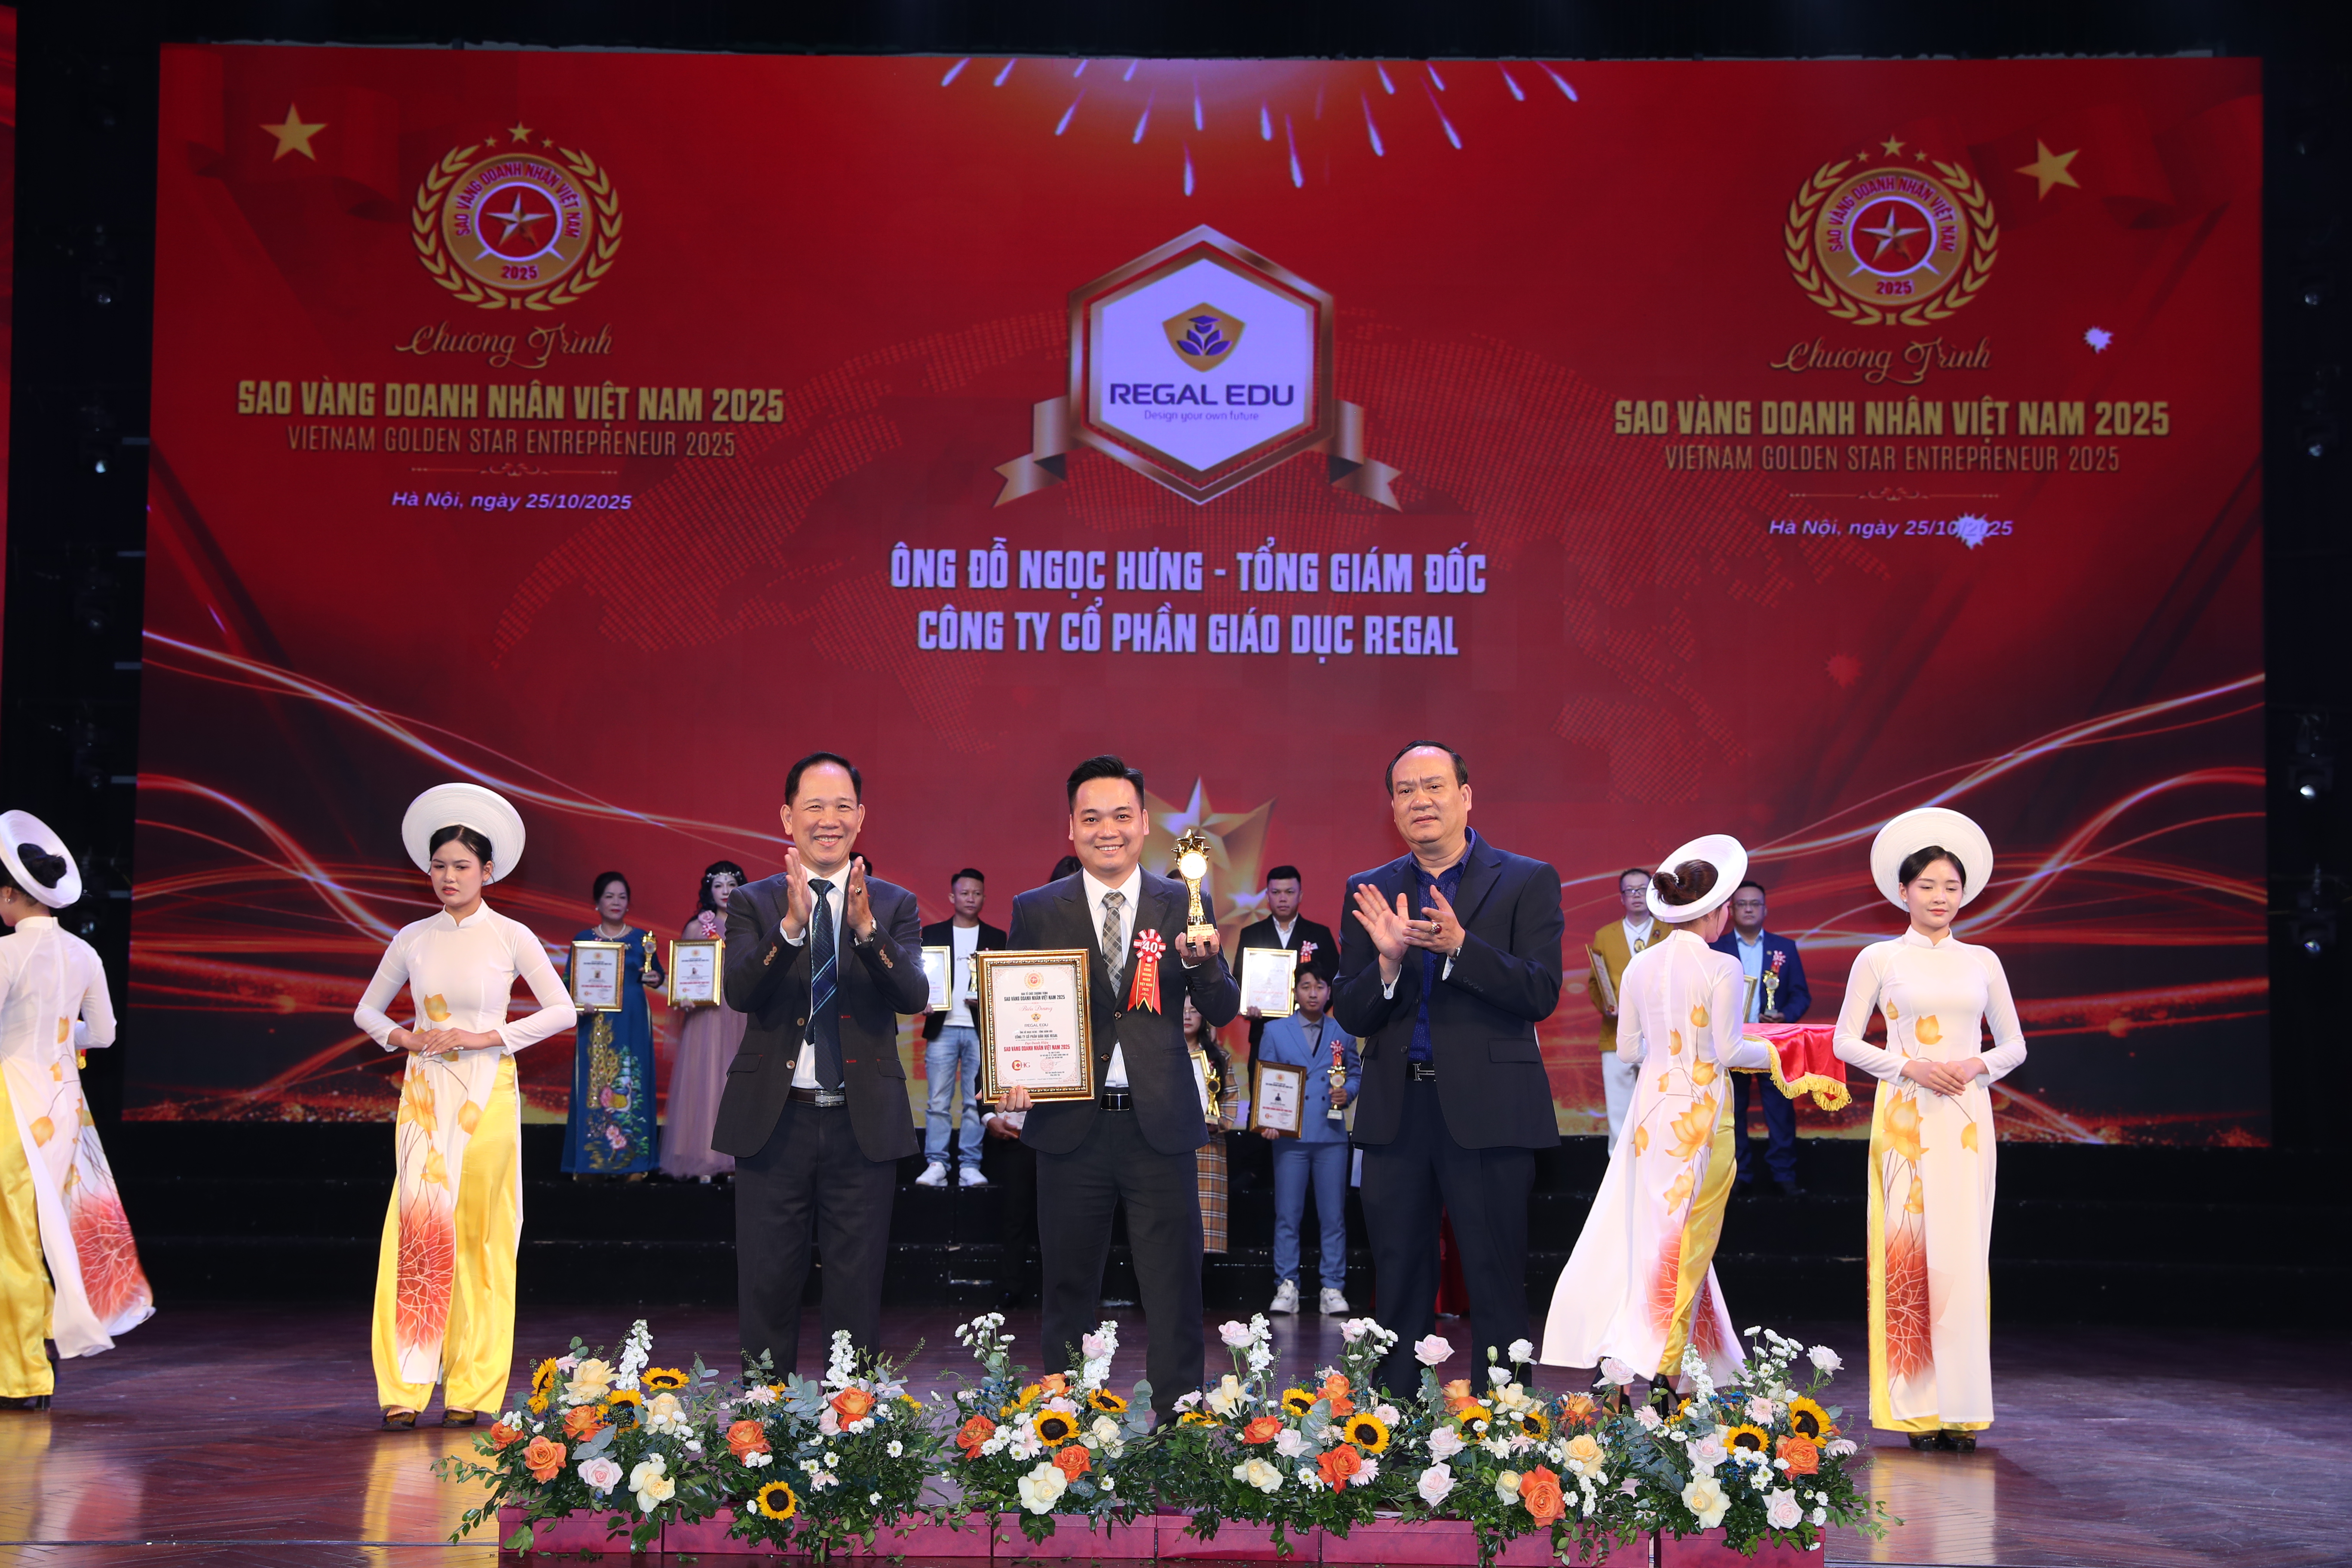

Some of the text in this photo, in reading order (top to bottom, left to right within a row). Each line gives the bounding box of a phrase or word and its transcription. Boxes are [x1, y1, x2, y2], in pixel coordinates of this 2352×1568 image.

[455, 162, 581, 239] SAO VÀNG DOANH NHÂN VIỆT NAM
[1828, 177, 1956, 252] SAO VÀNG DOANH NHÂN VIỆT NAM
[501, 265, 538, 279] 2025
[1875, 280, 1912, 295] 2025
[395, 321, 612, 369] Chương Trình
[1770, 337, 1991, 384] Chương Trình
[239, 376, 784, 428] SAO VÀNG DOANH NHÂN VIỆT NAM 2025
[1110, 383, 1294, 406] REGAL EDU
[1144, 410, 1259, 423] Design your own future
[1615, 395, 2168, 443] SAO VÀNG DOANH NHÂN VIỆT NAM 2025
[288, 426, 735, 457] VIETNAM GOLDEN STAR ENTREPRENEUR 2025
[1665, 444, 2119, 471] VIETNAM GOLDEN STAR ENTREPRENEUR 2025
[392, 491, 632, 512] Hà Nội, ngày 25/10/2025
[1769, 520, 1797, 535] Hà
[1802, 519, 1841, 537] Nội,
[1849, 520, 1900, 539] ngày
[891, 542, 956, 588] ÔNG
[968, 536, 1008, 588] ĐỖ
[1019, 550, 1106, 600] NGỌC
[1117, 547, 1203, 591] HƯNG
[1236, 536, 1319, 592] TỔNG
[1330, 546, 1413, 593] GIÁM
[1424, 542, 1486, 593] ĐỐC
[918, 596, 1459, 664] CÔNG TY CỔ PHẦN GIÁO DỤC REGAL
[1142, 940, 1158, 953] 40
